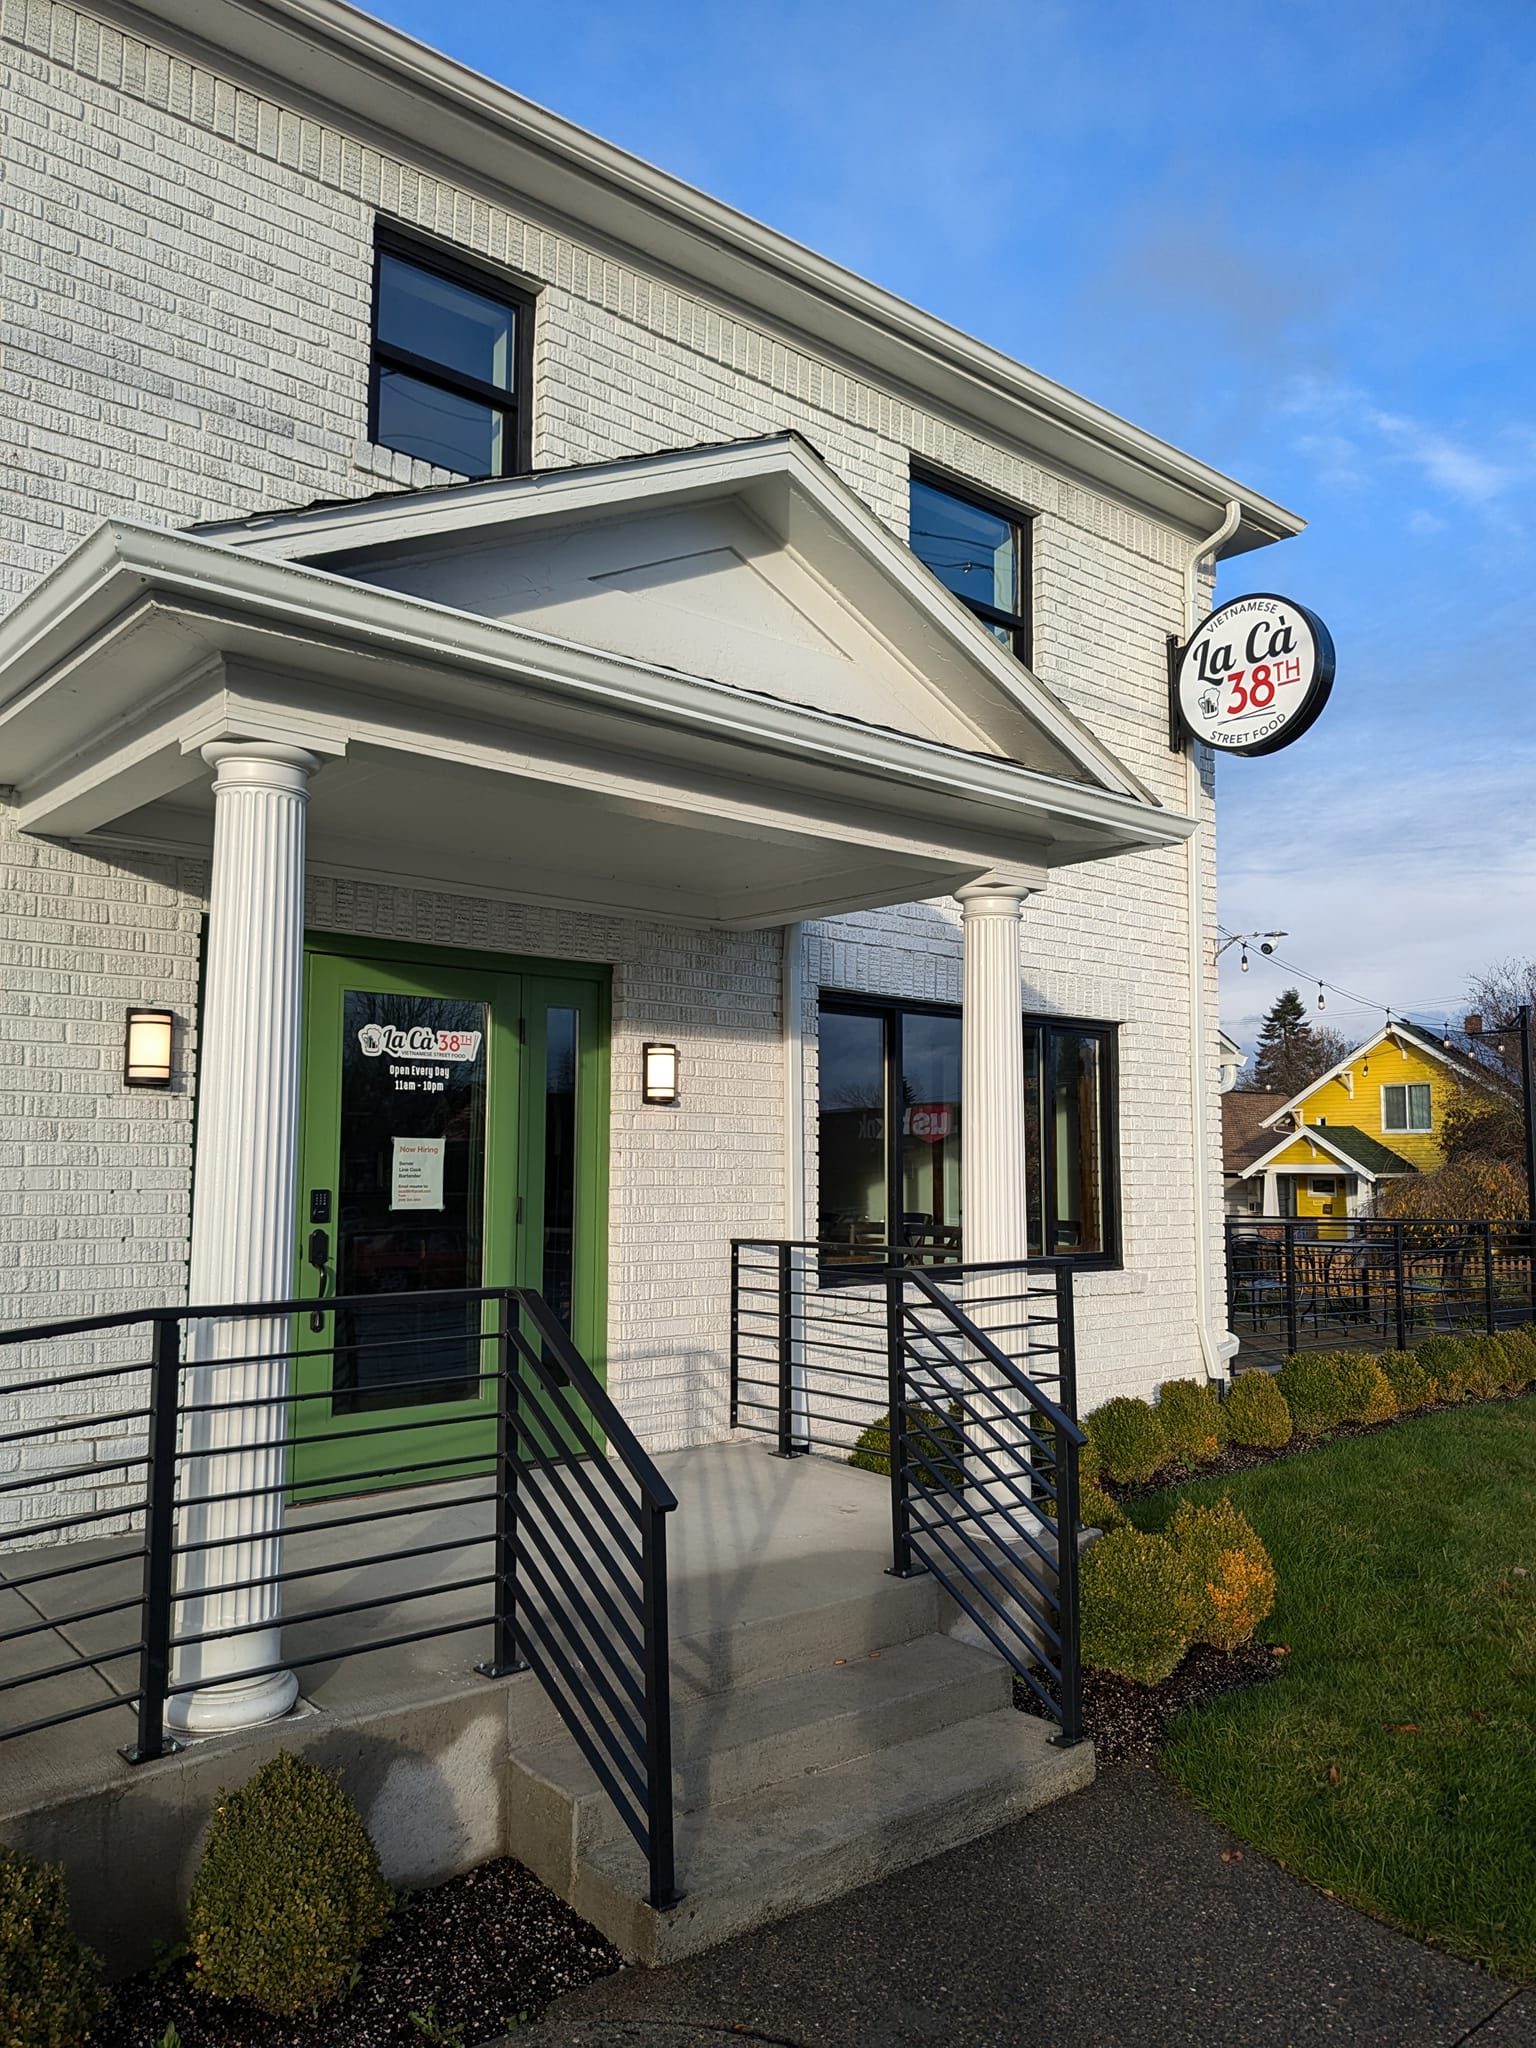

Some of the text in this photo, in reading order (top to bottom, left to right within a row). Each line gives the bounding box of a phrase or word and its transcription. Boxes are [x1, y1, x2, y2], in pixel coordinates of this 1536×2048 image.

[1206, 601, 1278, 633] VIETNAMESE
[1192, 615, 1298, 686] La Cà
[1226, 657, 1301, 714] 38TH
[1210, 713, 1287, 744] STREET FOOD
[383, 1028, 472, 1054] La Cà 38TH
[389, 1064, 450, 1080] Open Every Day
[394, 1080, 416, 1091] 11am
[423, 1081, 444, 1094] 10pm
[400, 1145, 439, 1154] Now Hiring
